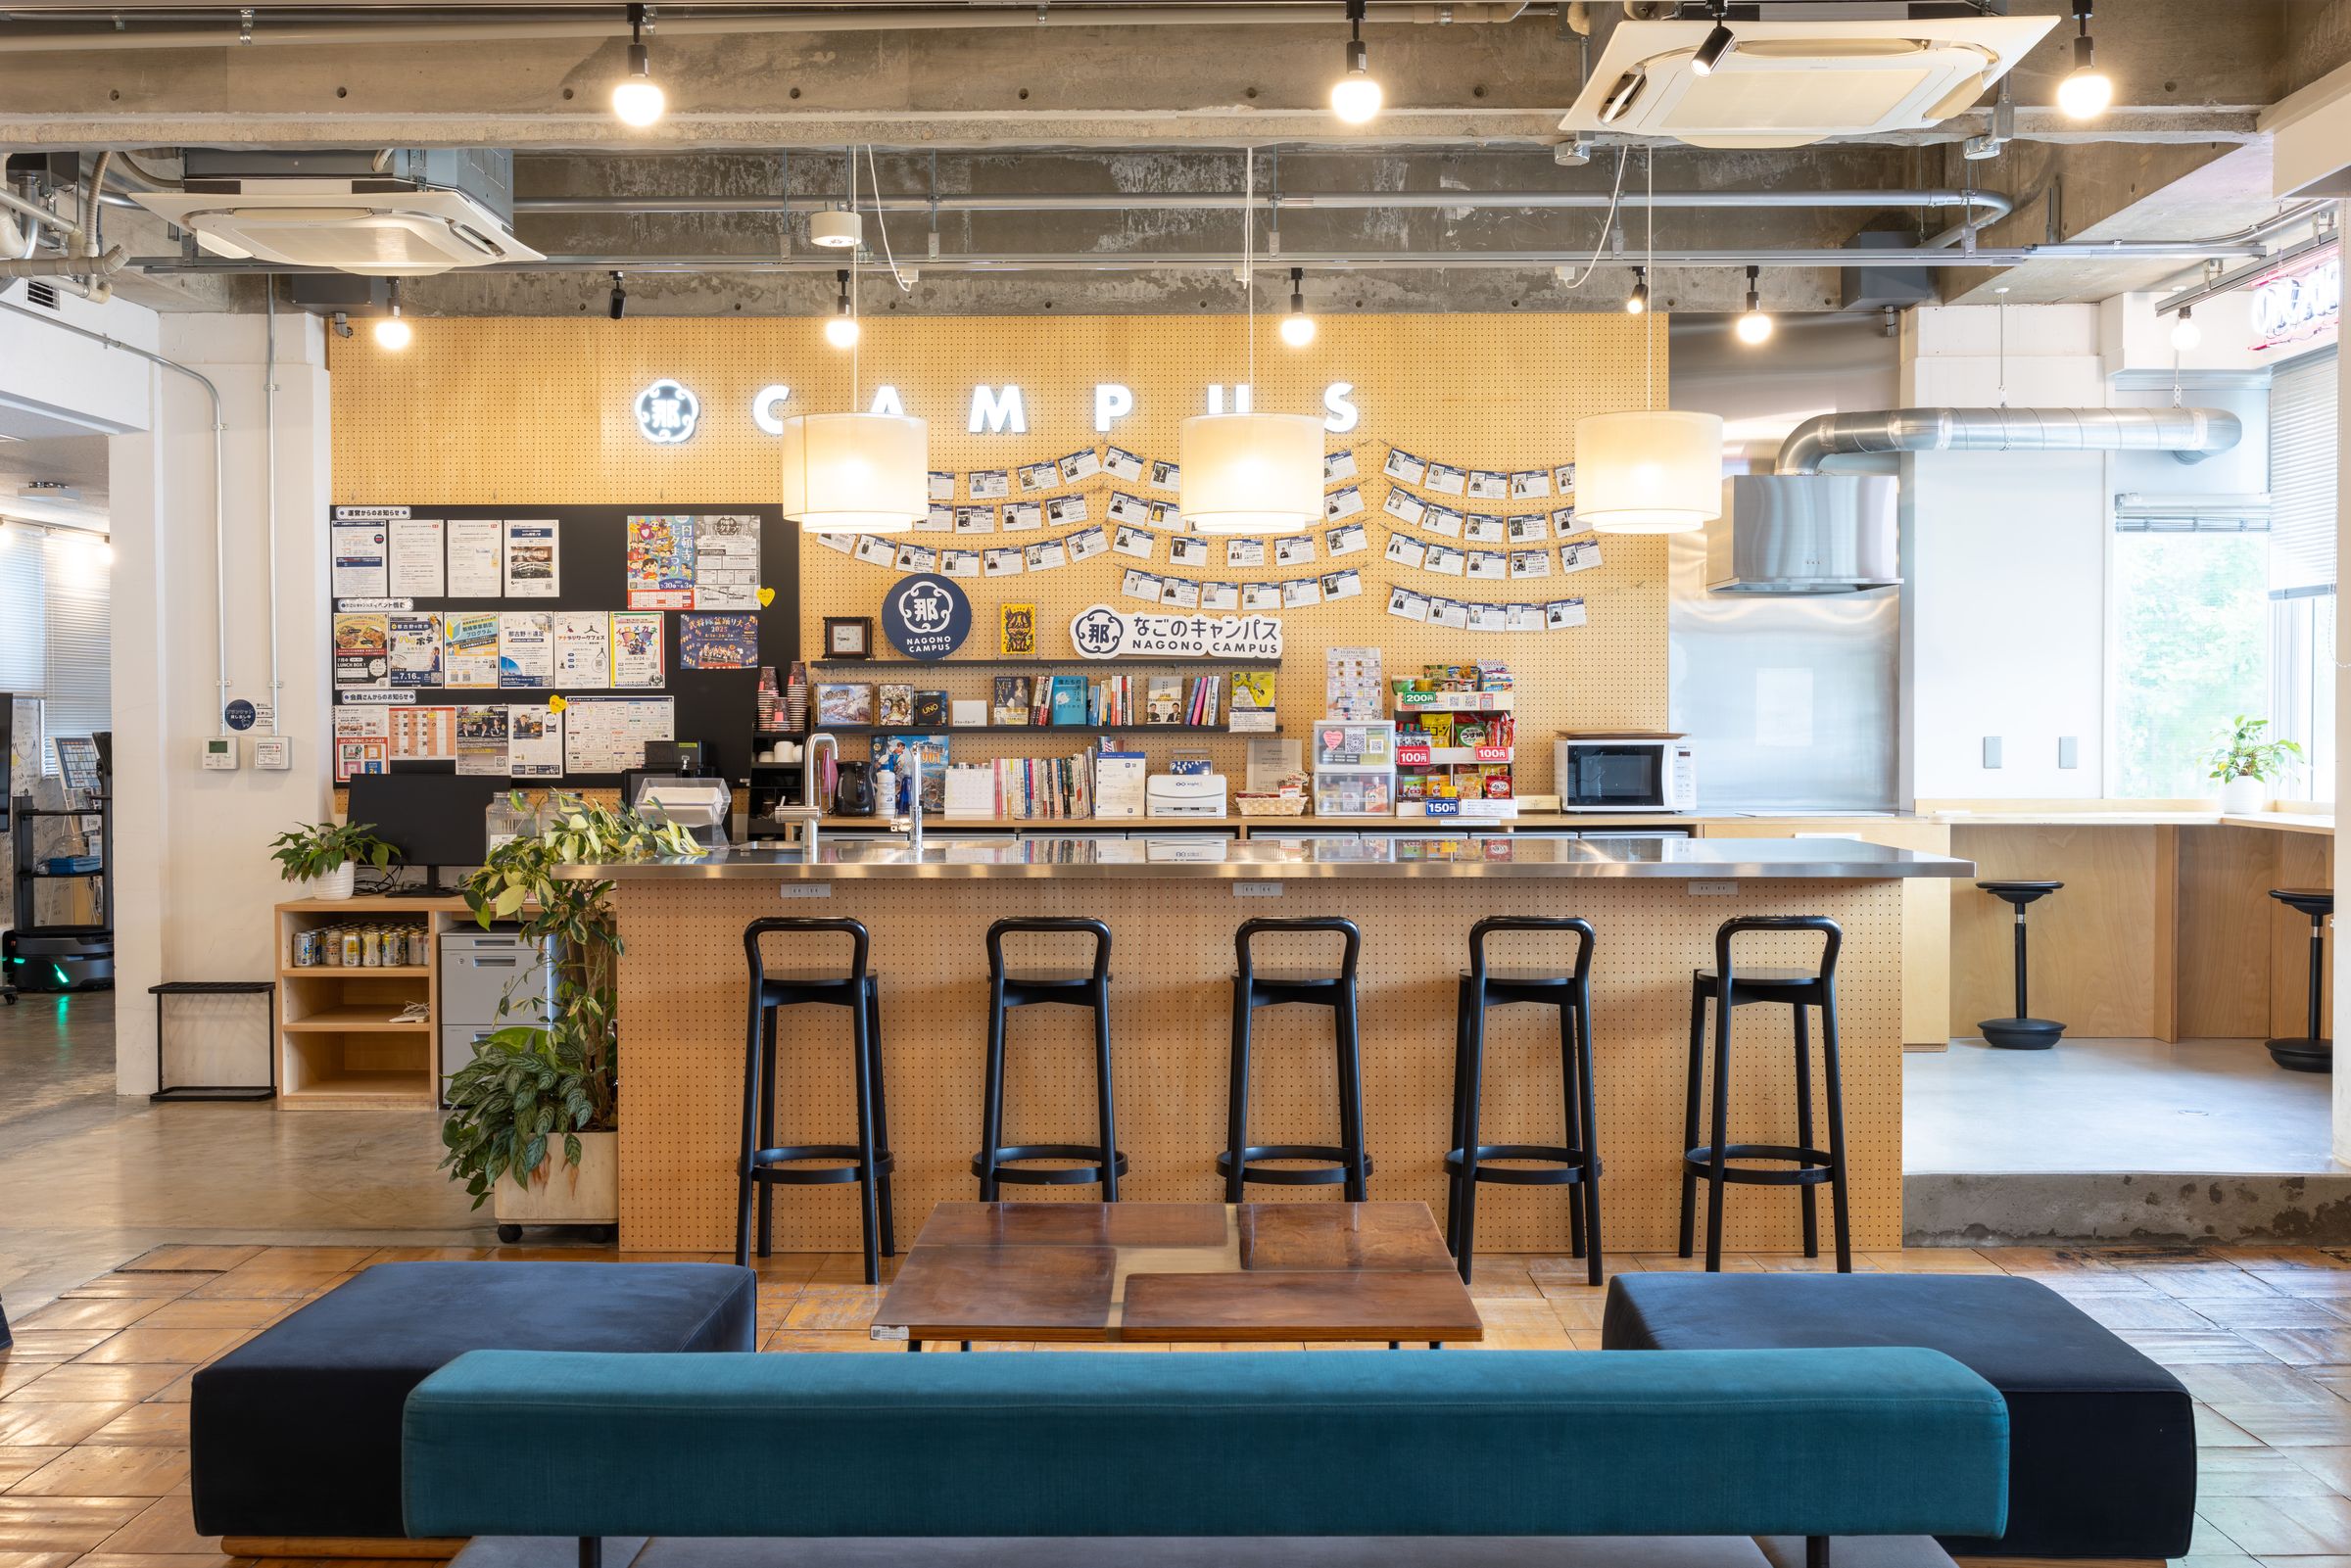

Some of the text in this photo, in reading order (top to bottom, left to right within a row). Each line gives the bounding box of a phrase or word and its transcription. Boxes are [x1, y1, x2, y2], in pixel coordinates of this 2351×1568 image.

[650, 399, 681, 428] 那
[752, 382, 1359, 434] CAMPUS
[913, 597, 939, 621] 那
[1088, 624, 1110, 643] 那
[1133, 616, 1277, 641] なごのキャンパス
[906, 636, 951, 645] NAGONO
[1132, 640, 1277, 653] NAGONO CAMPUS
[909, 643, 951, 653] CAMPUS
[922, 703, 938, 715] UNO
[921, 752, 940, 764] 901
[1401, 752, 1427, 762] 100円
[1479, 749, 1506, 758] 100円
[1428, 803, 1457, 813] 150円
